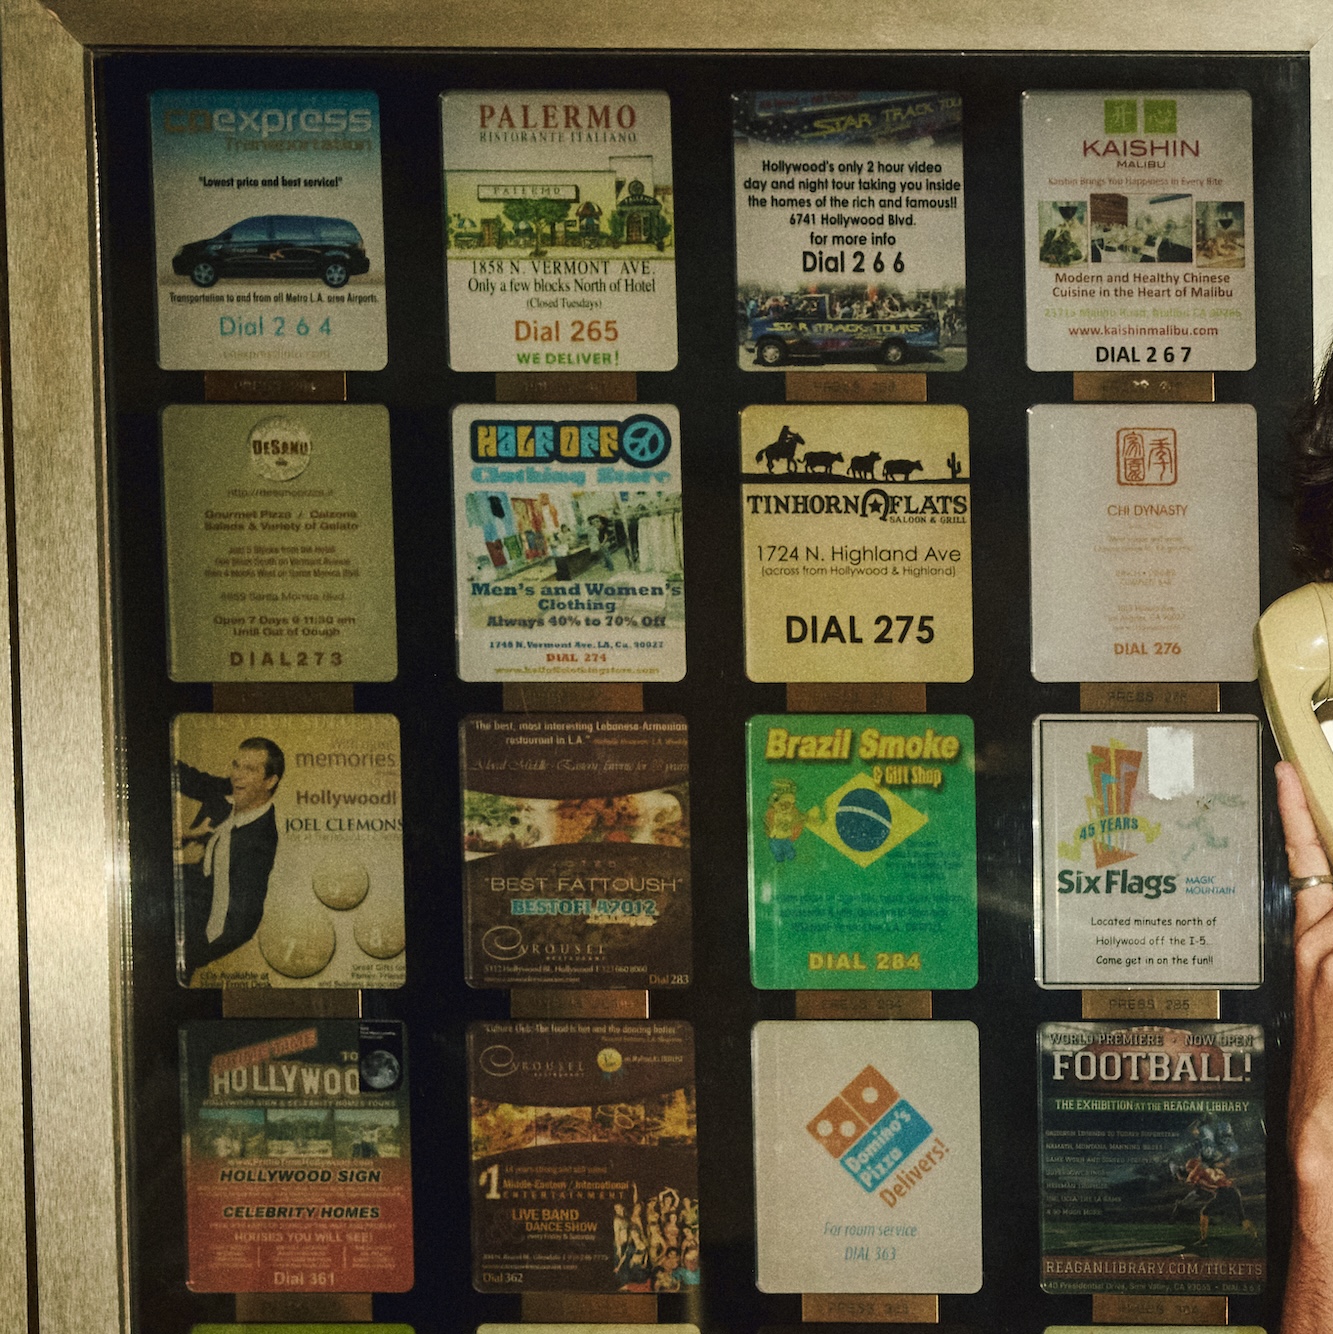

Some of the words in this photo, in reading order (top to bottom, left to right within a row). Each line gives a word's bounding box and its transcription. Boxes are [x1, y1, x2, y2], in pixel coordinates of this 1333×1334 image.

[479, 104, 637, 129] PALERMO
[1083, 140, 1199, 157] KAISHIN
[790, 214, 817, 226] 6741
[820, 213, 882, 228] Hollywood
[886, 213, 917, 228] Blvd.
[472, 259, 505, 275] 1858
[511, 260, 525, 275] N.
[530, 260, 611, 275] VERMONT
[619, 260, 656, 275] AVE.
[1055, 272, 1102, 284] Modern
[1107, 272, 1130, 284] and
[1134, 272, 1179, 287] Healthy
[1183, 272, 1230, 284] Chinese
[515, 320, 559, 343] Dial
[570, 320, 618, 343] 265
[1068, 324, 1218, 337] www.kaishinmalibu.com
[747, 496, 861, 516] TINHORN
[889, 496, 967, 516] FLATS
[757, 545, 799, 563] 1724
[805, 545, 825, 563] N.
[832, 544, 920, 565] Highland
[926, 545, 961, 563] Ave
[786, 616, 862, 644] DIAL
[874, 616, 935, 644] 275
[767, 730, 850, 759] Brazil
[858, 731, 958, 759] Smoke
[1058, 869, 1100, 895] Six
[1104, 869, 1177, 899] Flags
[1091, 916, 1130, 927] Located
[1134, 916, 1171, 927] minutes
[1176, 916, 1202, 927] north
[1205, 916, 1217, 927] of
[1053, 1052, 1252, 1082] FOOTBALL!
[220, 1169, 331, 1183] HOLLYWOOD
[338, 1170, 381, 1183] SIGN
[224, 1206, 314, 1219] CELEBRITY
[320, 1206, 379, 1219] HOMES
